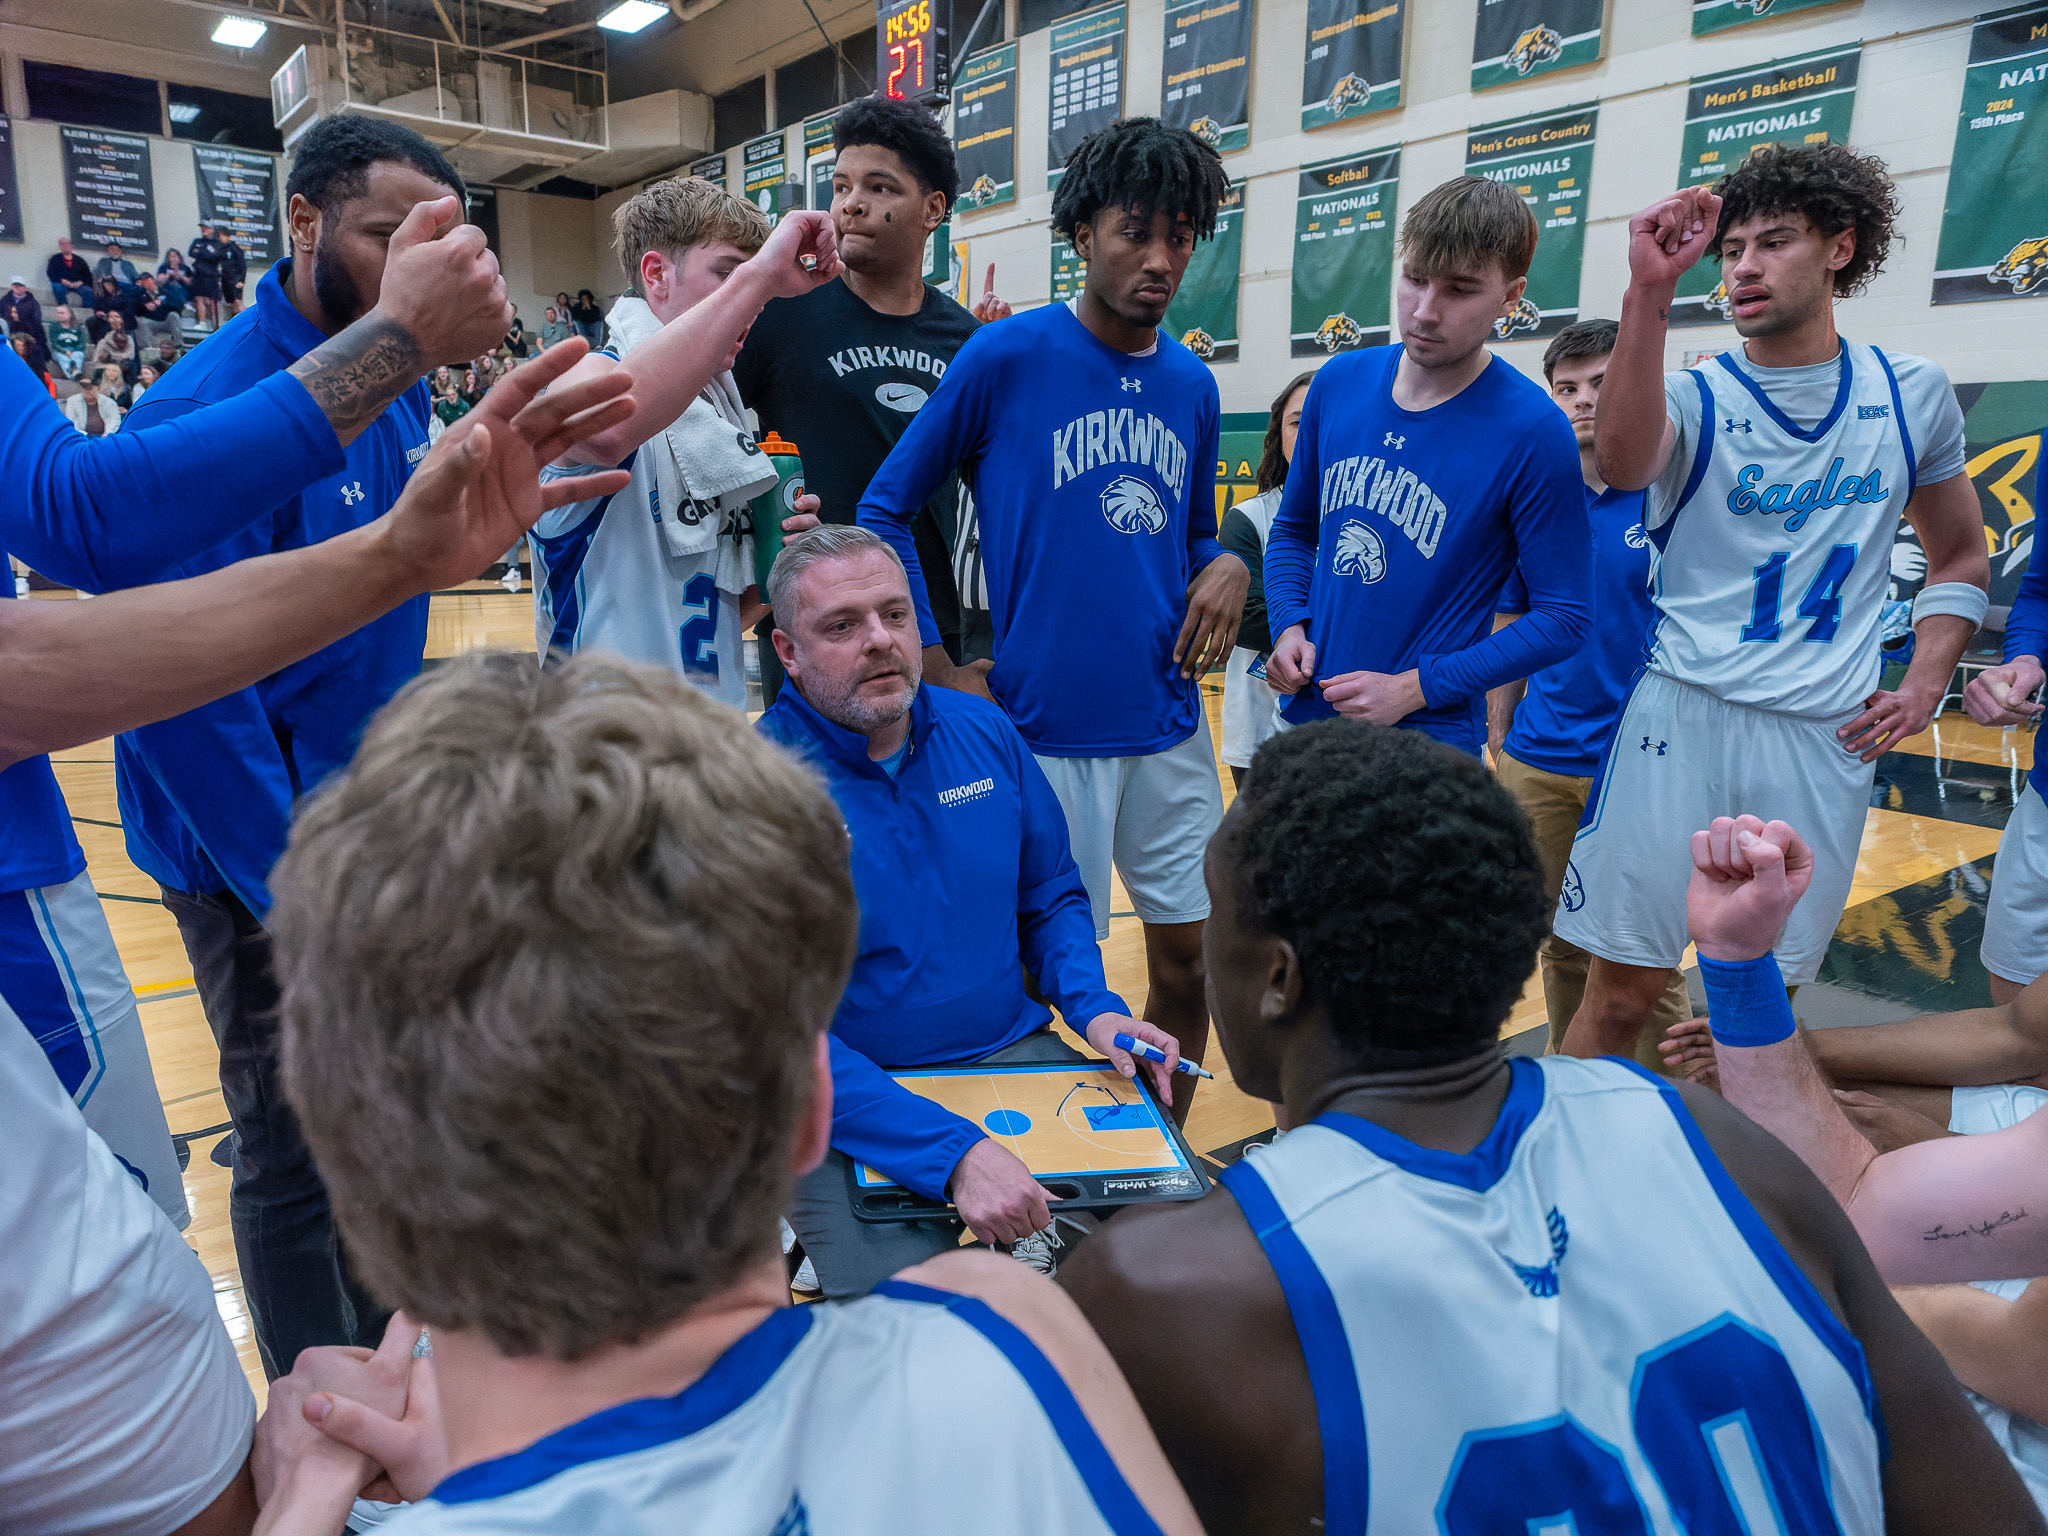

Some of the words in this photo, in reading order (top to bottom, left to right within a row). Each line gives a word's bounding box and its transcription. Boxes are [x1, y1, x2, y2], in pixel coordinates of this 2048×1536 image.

[887, 0, 930, 43] 14:56
[888, 38, 923, 100] 27
[1704, 87, 1748, 109] Men's
[1751, 65, 1838, 99] Basketball
[1969, 116, 1994, 130] 15th
[1993, 111, 2025, 126] Place
[1985, 98, 2014, 113] 2024
[1471, 139, 1503, 155] Men's
[1504, 133, 1538, 149] Cross
[1540, 123, 1591, 142] Country
[1706, 106, 1823, 144] NATIONALS
[1327, 166, 1369, 186] Softball
[1482, 157, 1571, 183] NATIONALS
[1312, 192, 1380, 216] NATIONALS
[827, 346, 947, 379] KIRKWOO
[1053, 408, 1187, 503] KIRKWOOD
[1320, 455, 1447, 560] KIRKWOOD
[1727, 456, 1889, 532] Eagles
[1738, 543, 1858, 644] 14
[938, 777, 995, 805] KIRKWOOD
[948, 792, 991, 808] BASKETBALL
[1147, 1177, 1190, 1189] Sport
